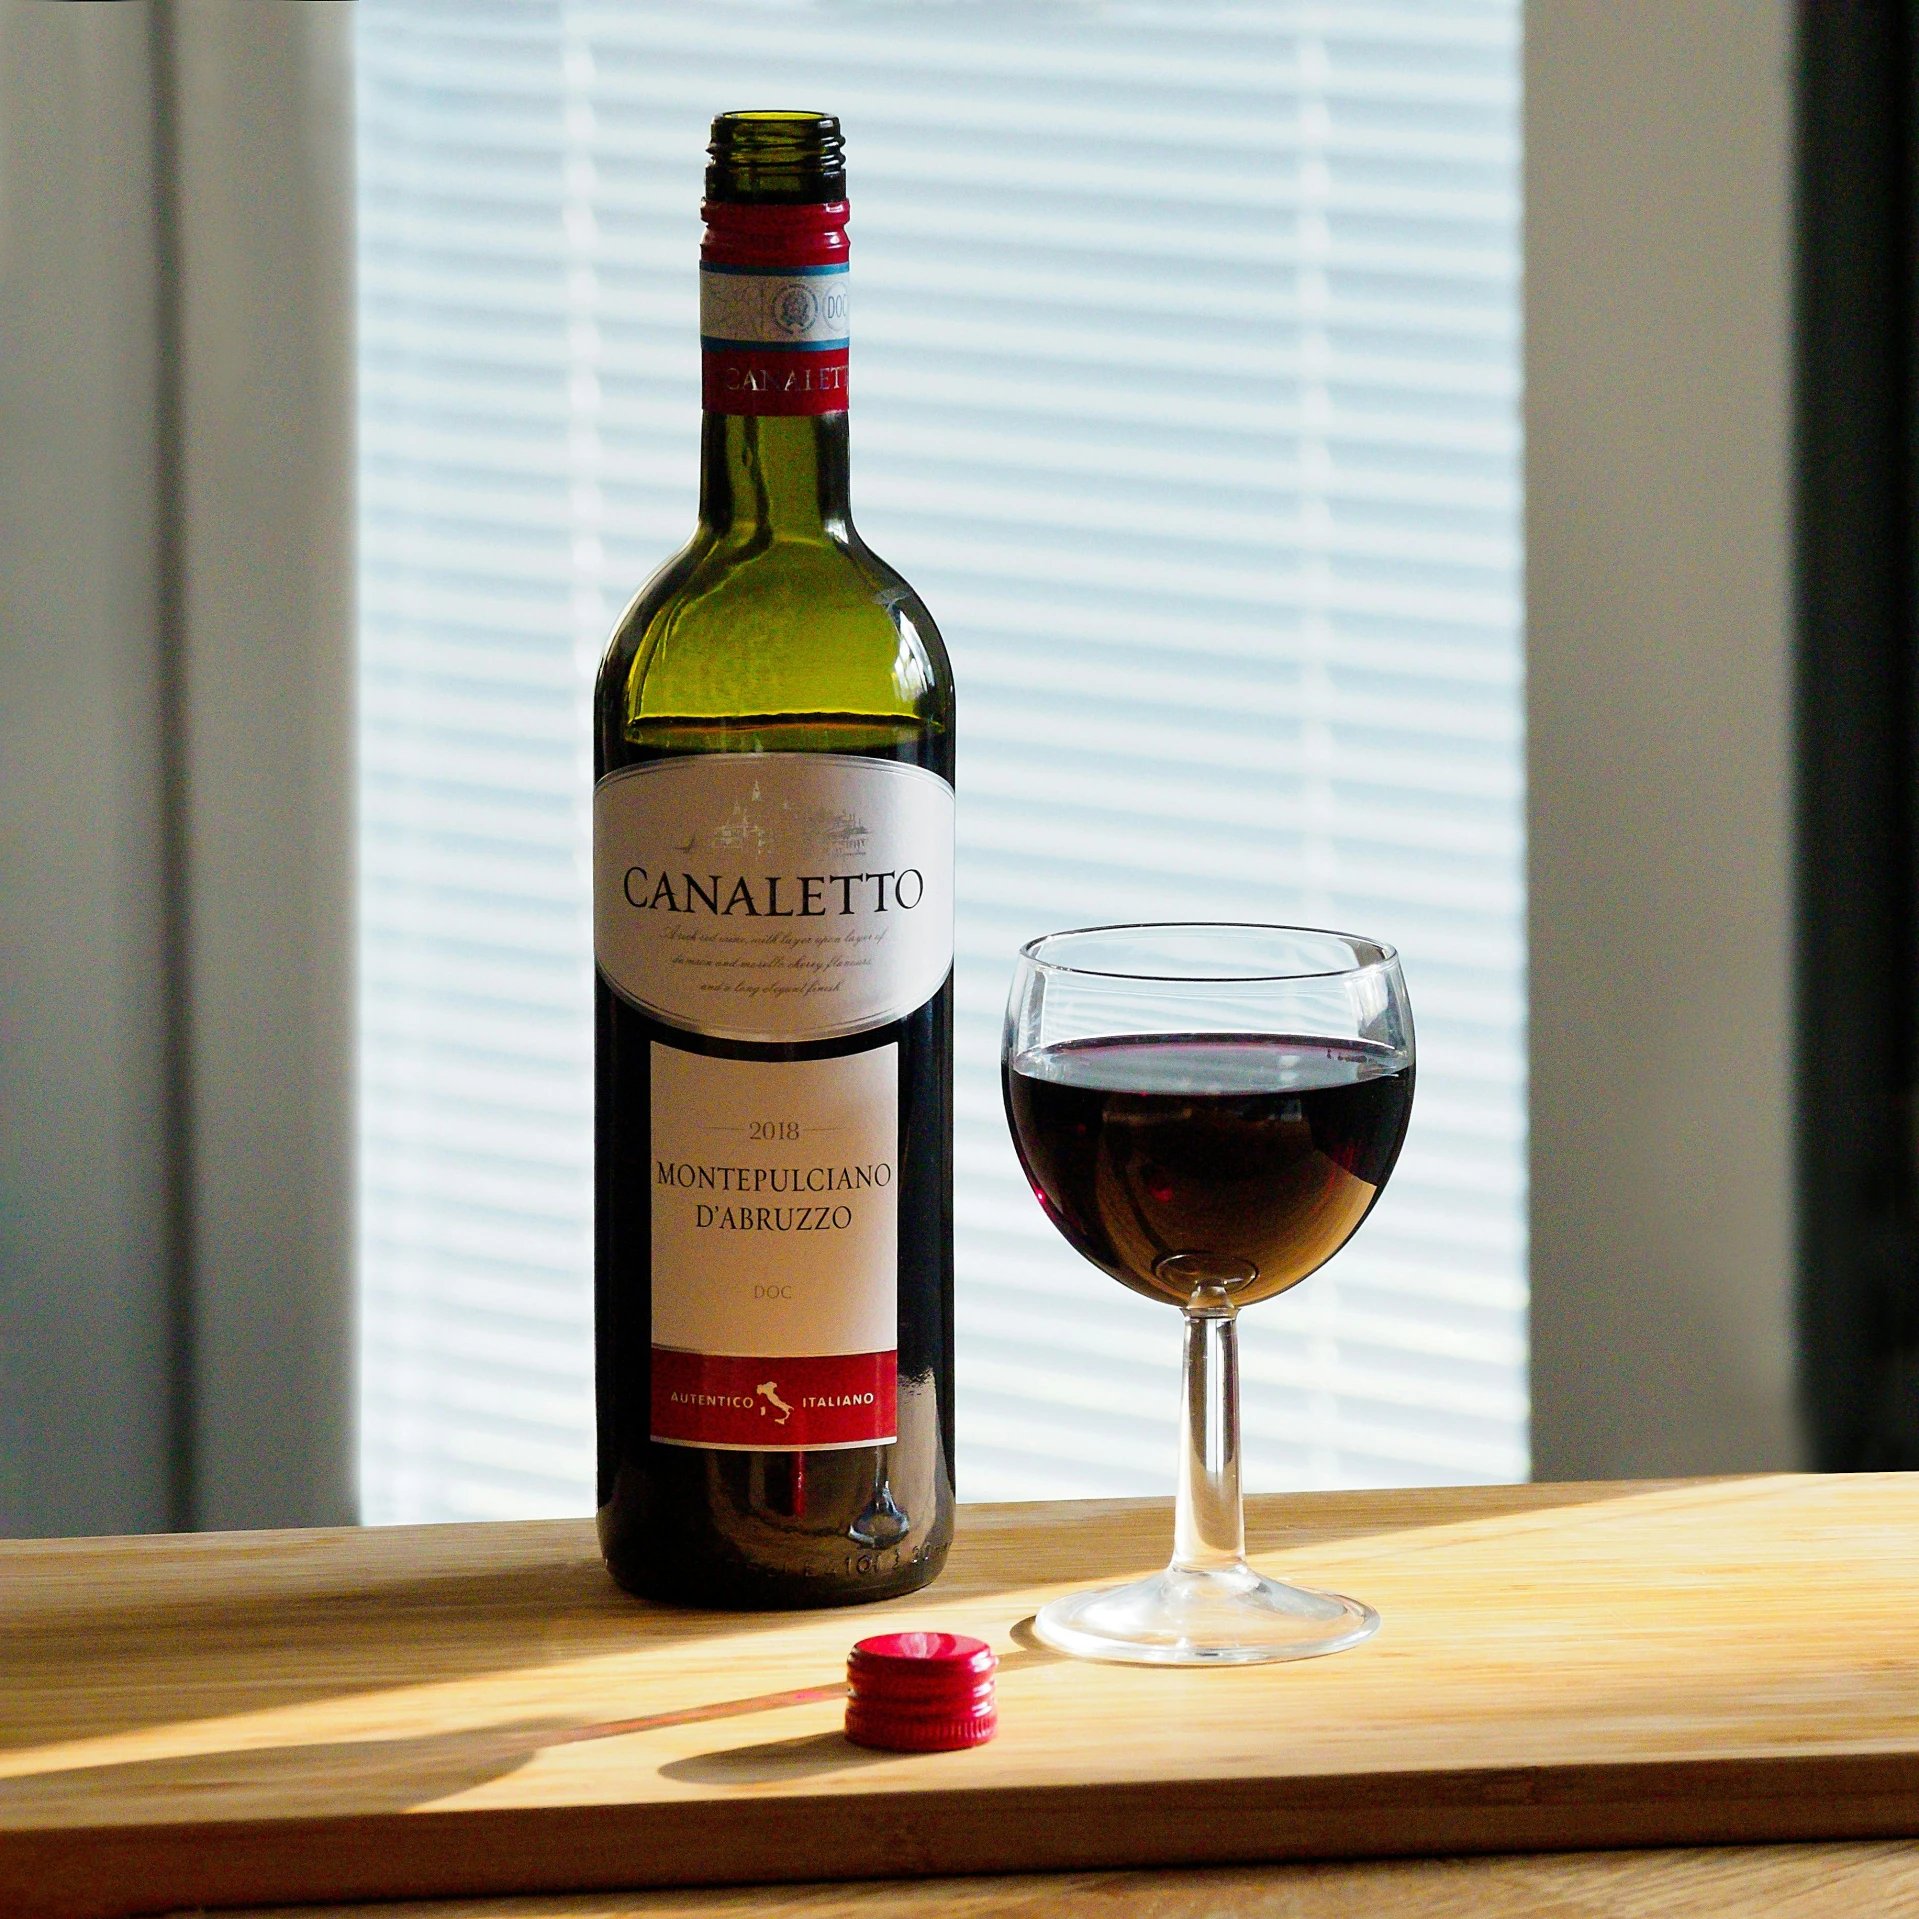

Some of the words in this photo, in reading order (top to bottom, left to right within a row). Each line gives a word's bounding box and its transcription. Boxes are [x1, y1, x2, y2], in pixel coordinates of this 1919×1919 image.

[624, 866, 925, 917] CANALETTO
[749, 1121, 800, 1141] 2018
[656, 1161, 892, 1193] MONTEPULCIANO
[695, 1204, 852, 1231] D'ABRUZZO
[753, 1285, 793, 1300] DOC
[670, 1391, 754, 1409] AUTENTICO
[802, 1392, 874, 1408] ITALIANO
